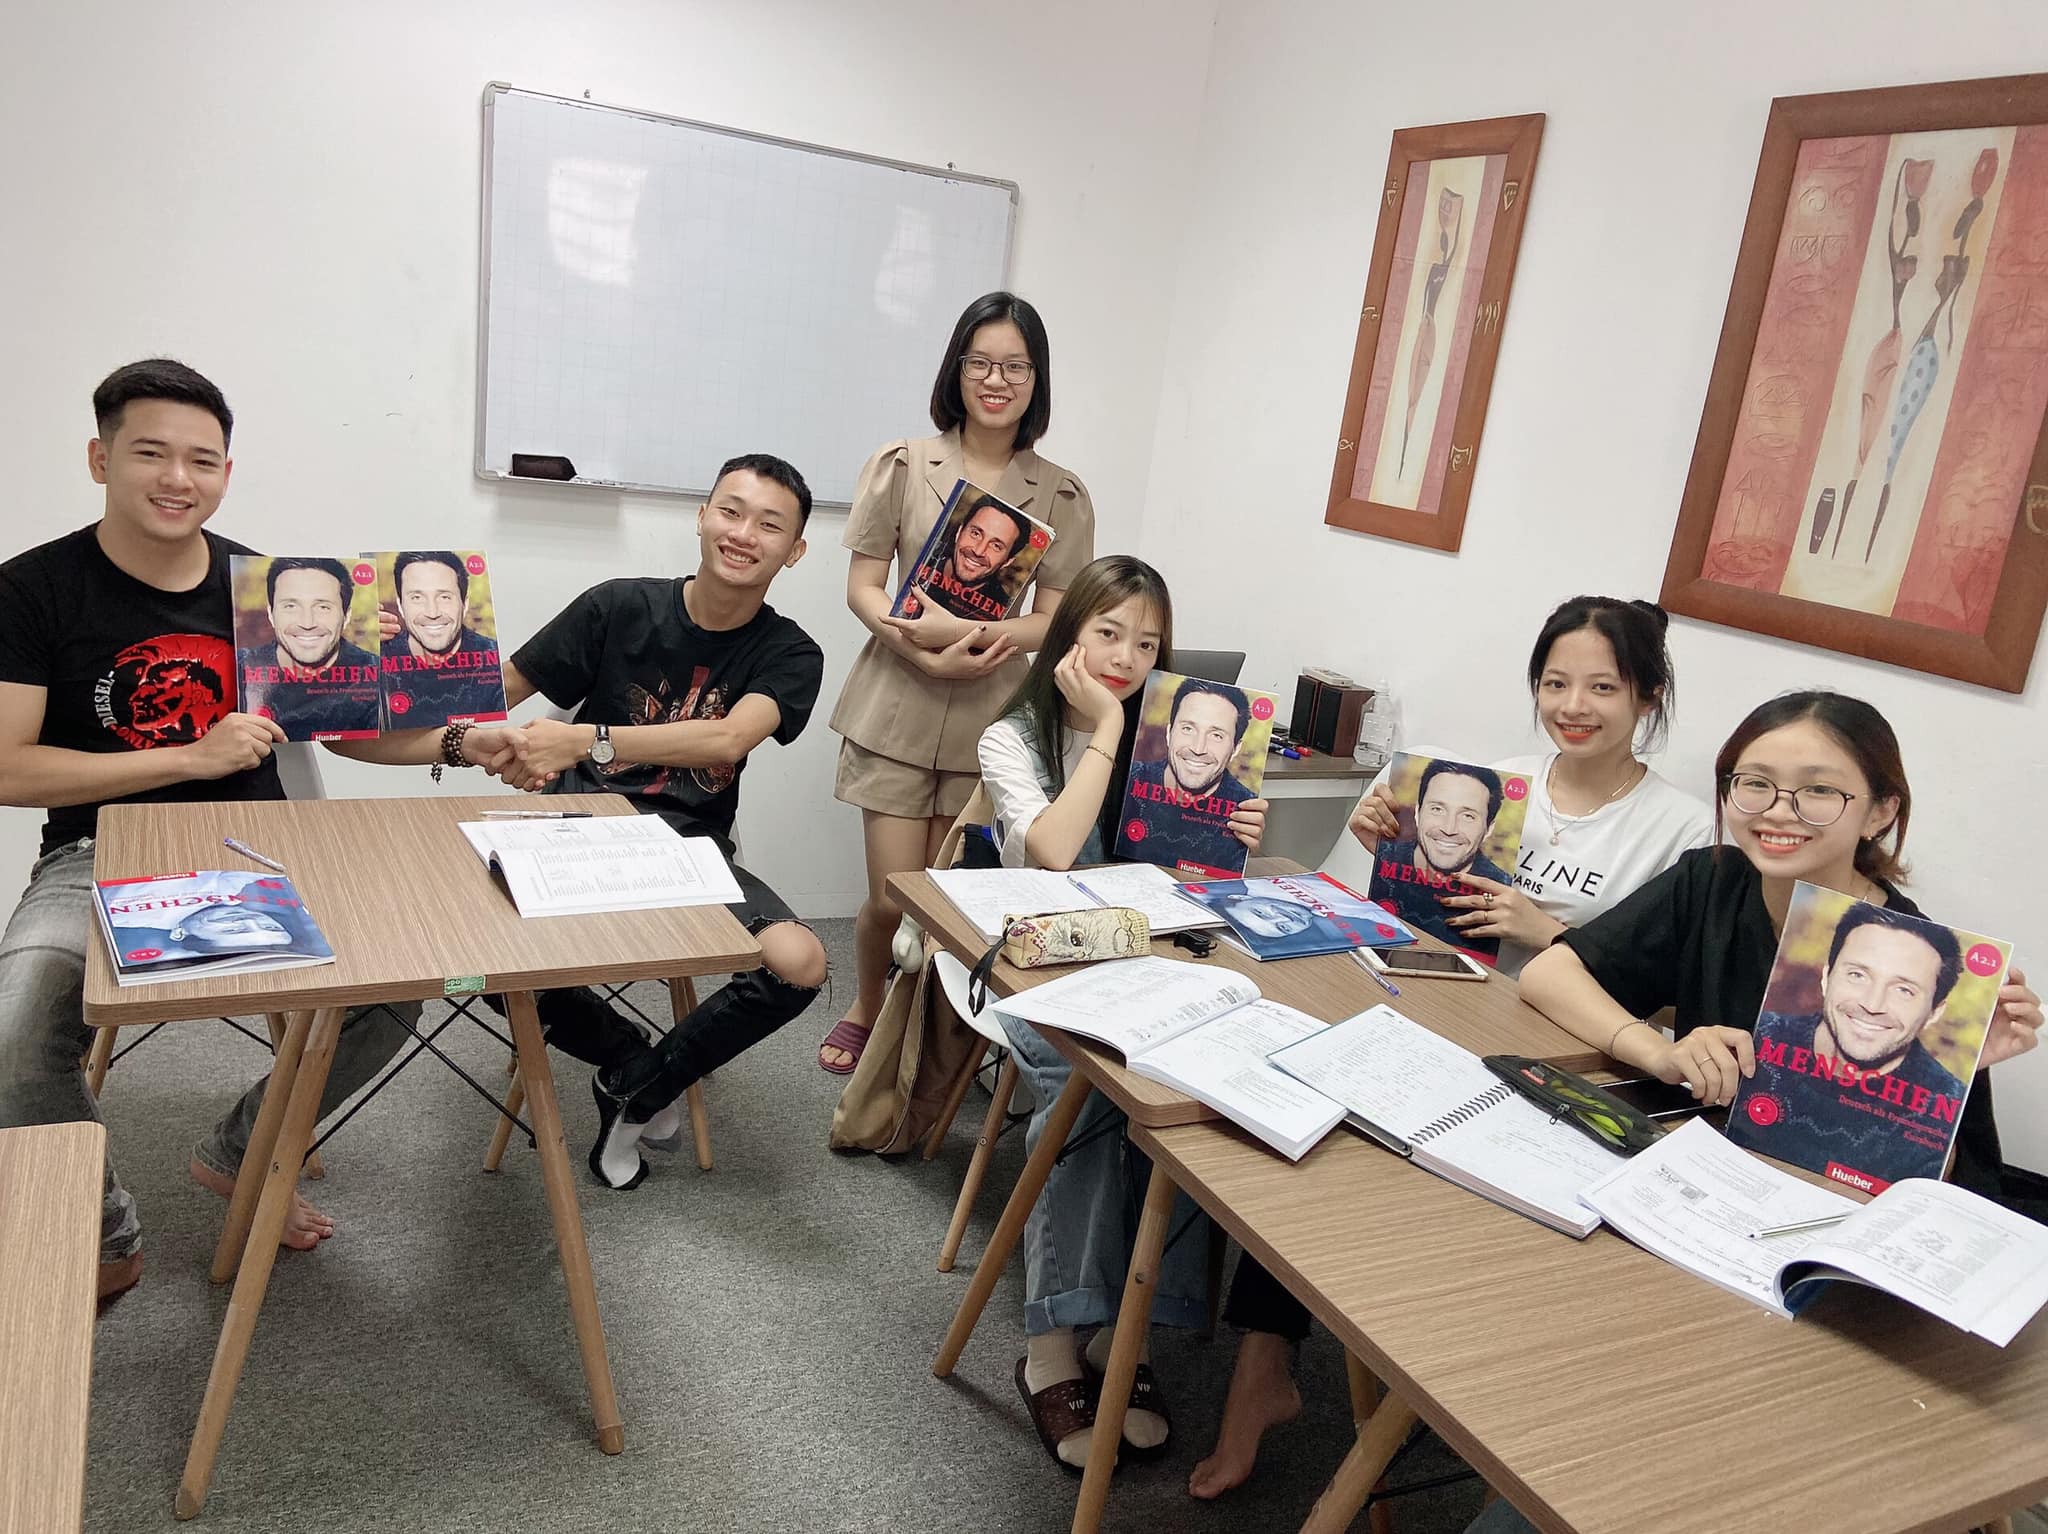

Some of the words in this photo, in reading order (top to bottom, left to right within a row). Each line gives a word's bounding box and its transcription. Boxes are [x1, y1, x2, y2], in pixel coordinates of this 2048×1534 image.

[916, 566, 1007, 618] MENSCHEN
[242, 665, 379, 684] MENSCHEN
[381, 650, 499, 673] MENSCHEN
[94, 678, 118, 728] DIESEL
[1130, 779, 1239, 817] MENSCHE
[1180, 863, 1206, 876] Hueber
[1378, 860, 1473, 896] MENSC
[1519, 846, 1604, 897] LINE
[1970, 951, 1997, 969] A2.1
[1757, 1037, 1962, 1122] MENSCHEN
[1831, 1166, 1874, 1191] Hueber
[1069, 1399, 1086, 1411] VIP
